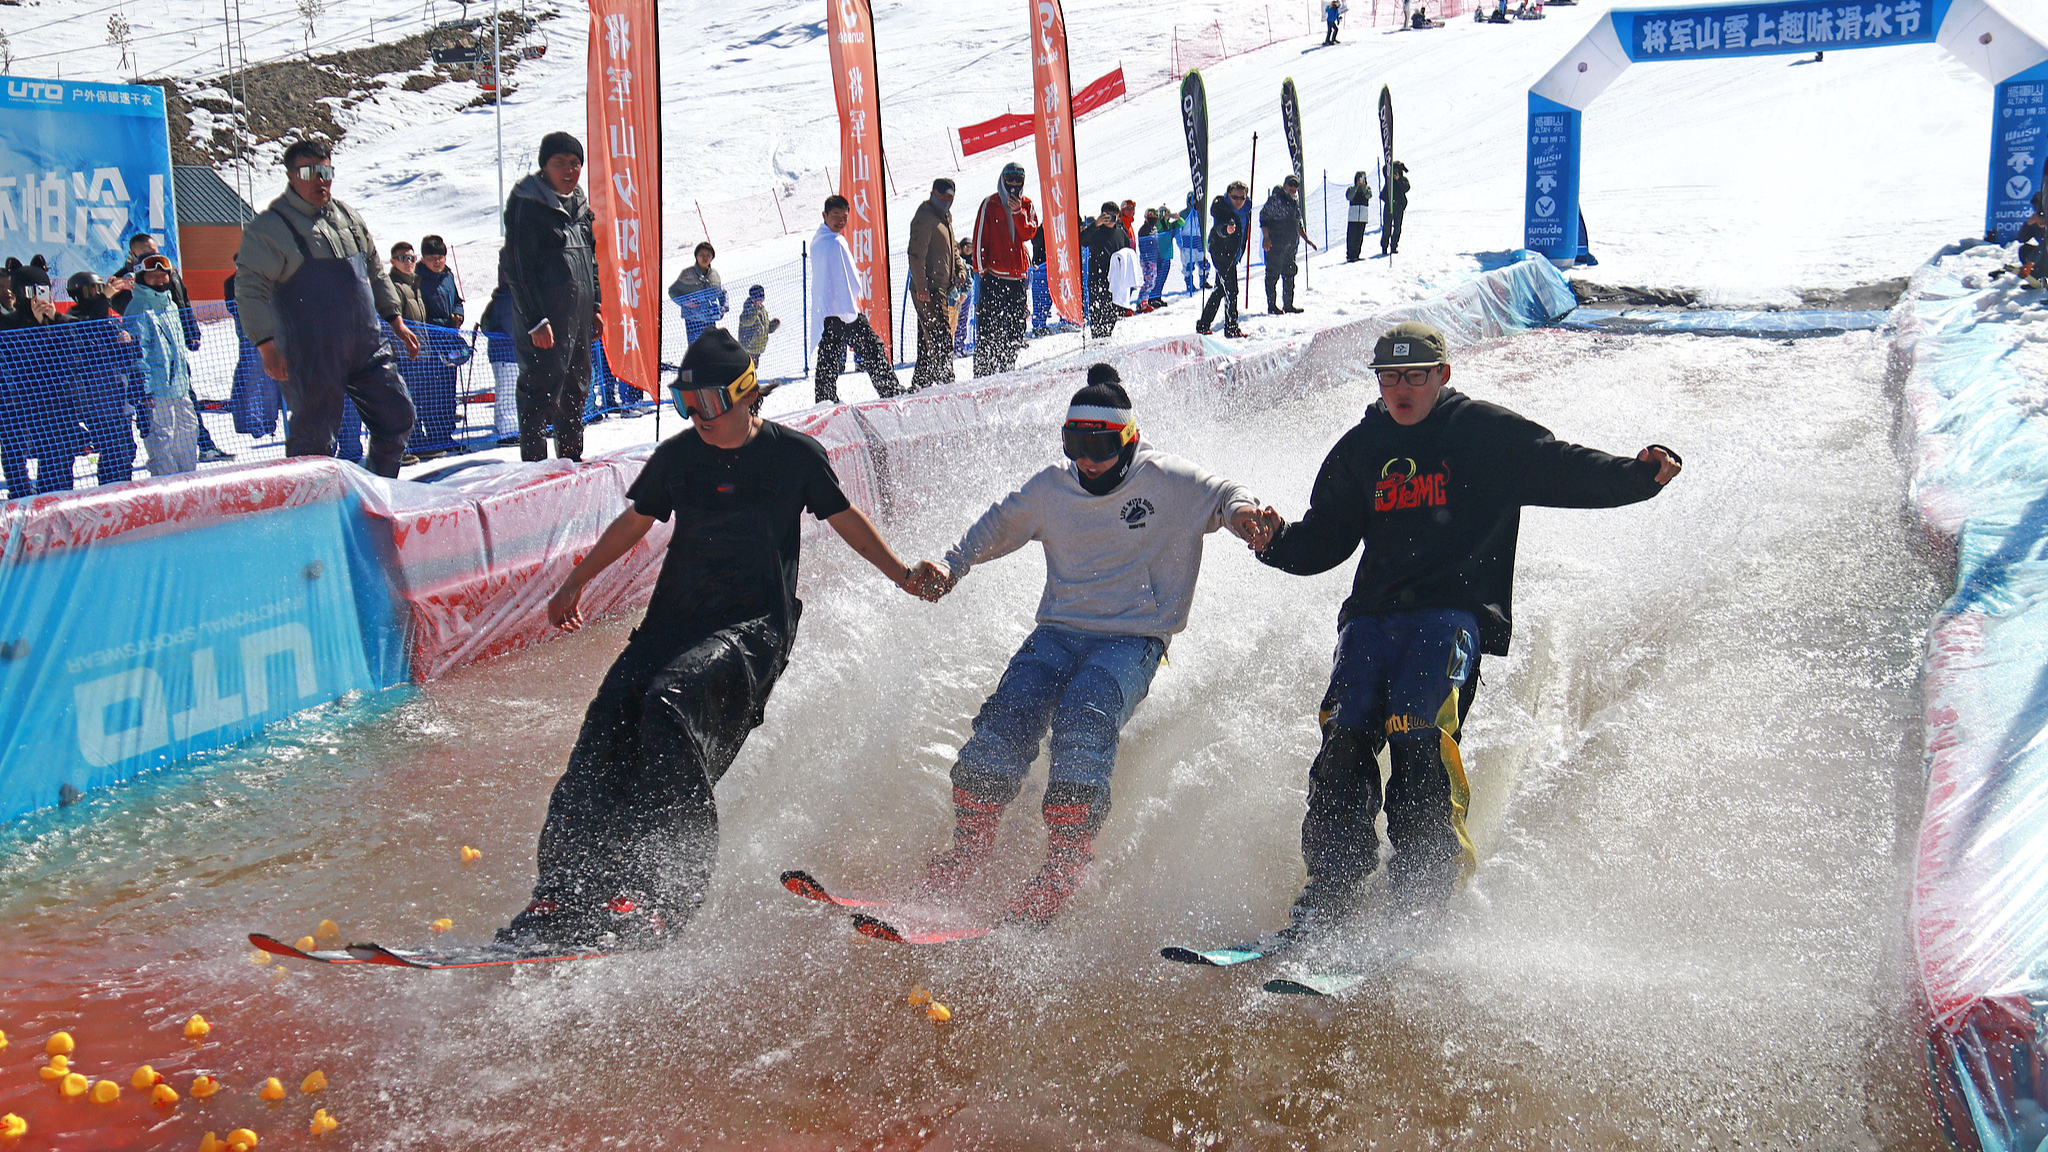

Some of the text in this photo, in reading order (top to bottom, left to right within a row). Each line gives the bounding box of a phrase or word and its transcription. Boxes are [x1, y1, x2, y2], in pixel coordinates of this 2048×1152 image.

[1642, 1, 1921, 53] 将军山雪上趣味滑水节
[7, 81, 64, 100] UTO
[72, 88, 153, 106] 户外保暖速干衣
[1995, 206, 2034, 219] sunsid
[1528, 223, 1563, 234] sunside
[66, 627, 199, 674] SPORTSWEAR
[73, 621, 319, 767] UTO
